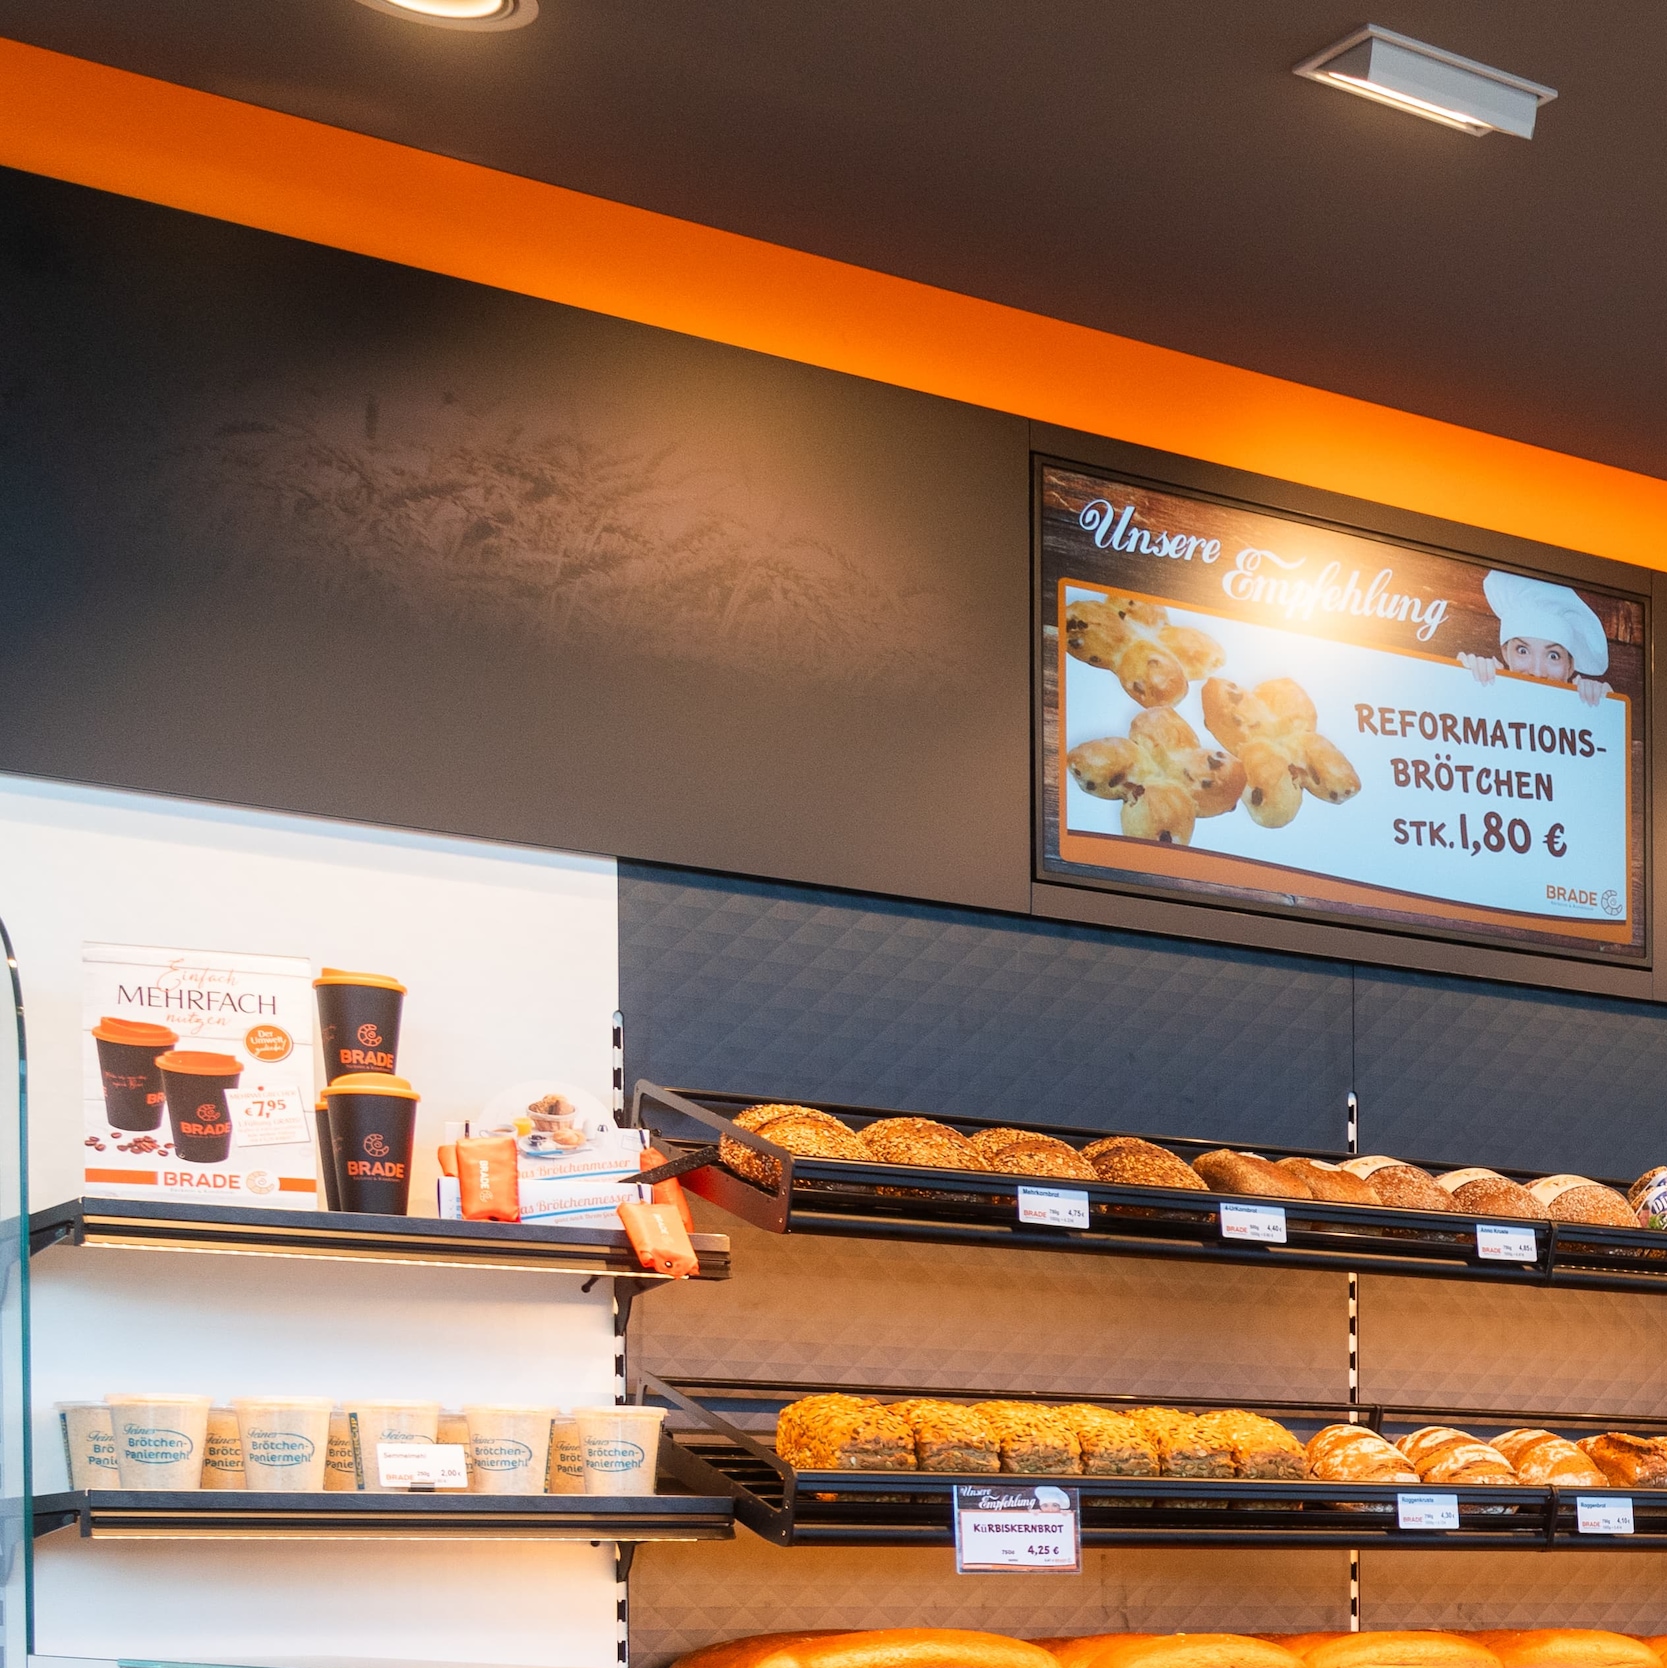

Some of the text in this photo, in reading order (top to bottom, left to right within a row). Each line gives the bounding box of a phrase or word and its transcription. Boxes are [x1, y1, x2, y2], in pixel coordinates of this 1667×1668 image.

[1078, 498, 1222, 565] Unsere
[1222, 548, 1449, 642] Empfehlung
[1355, 703, 1606, 758] REFORMATIONS-
[1390, 753, 1554, 803] BRÖTCHEN
[1542, 823, 1568, 858] €
[1546, 884, 1598, 906] BRADE
[157, 958, 240, 993] Einfach
[118, 985, 276, 1015] MEHRFACH
[166, 1012, 230, 1034] nutzen
[258, 1030, 274, 1038] Der
[251, 1036, 284, 1045] Umwelt
[340, 1049, 394, 1069] BRADE
[180, 1121, 232, 1135] BRADE
[348, 1160, 405, 1179] BRADE
[538, 1157, 631, 1177] Brötchenmesser
[479, 1160, 490, 1188] BRADE
[164, 1171, 241, 1190] BRADE
[1022, 1188, 1060, 1197] Mehrkornbrot
[537, 1191, 633, 1212] Brötchenmesser
[1023, 1209, 1047, 1218] BRADE
[1226, 1225, 1248, 1233] BRADE
[1481, 1246, 1501, 1254] BRADE
[124, 1423, 155, 1435] Feines
[247, 1427, 278, 1439] Feines
[380, 1429, 415, 1442] Feines
[584, 1435, 609, 1446] Feines
[128, 1437, 188, 1448] Brötchen-
[251, 1440, 308, 1451] Brötchen-
[125, 1449, 190, 1461] Paniermehl
[249, 1452, 312, 1463] Paniermehl
[383, 1451, 427, 1460] Semmelmehl
[475, 1446, 525, 1457] Brötchen-
[588, 1447, 639, 1458] Brötchen-
[474, 1457, 529, 1469] Paniermehl
[586, 1458, 641, 1469] Paniermehl
[386, 1473, 414, 1482] BRADE
[960, 1486, 992, 1497] Unsere
[979, 1492, 1037, 1511] Empfehlung
[1028, 1545, 1059, 1556] 4,25 €
